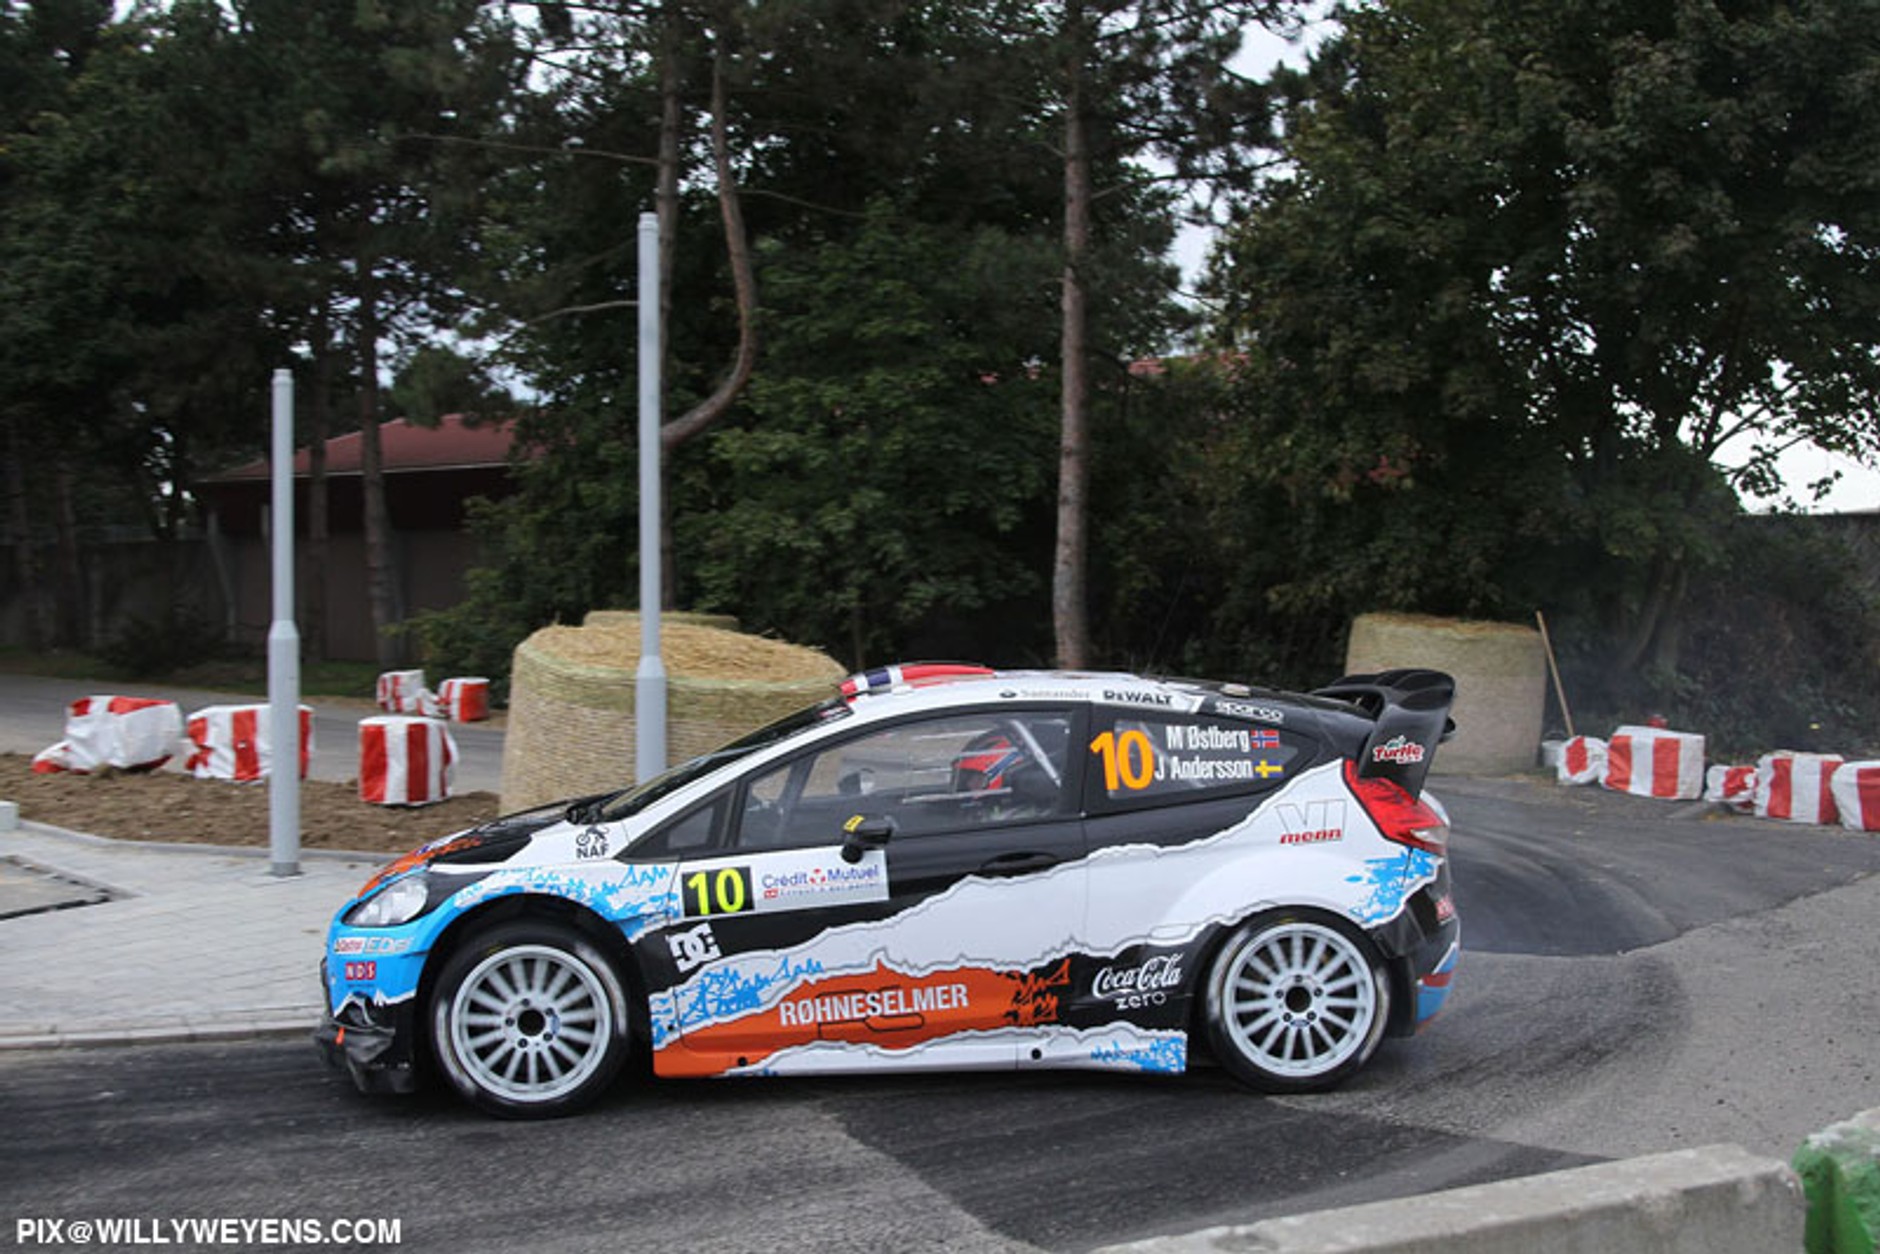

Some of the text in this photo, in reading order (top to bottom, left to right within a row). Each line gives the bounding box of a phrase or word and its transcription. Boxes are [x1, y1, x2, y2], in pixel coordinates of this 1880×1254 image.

[1165, 724, 1251, 753] M Østberg
[1090, 729, 1155, 790] 10
[1154, 755, 1254, 781] J Andersson
[576, 843, 609, 858] NAF
[761, 864, 879, 889] Crédit Mutuel
[687, 868, 745, 915] 10
[780, 983, 969, 1027] RØHNESELMER
[1115, 991, 1167, 1011] zero
